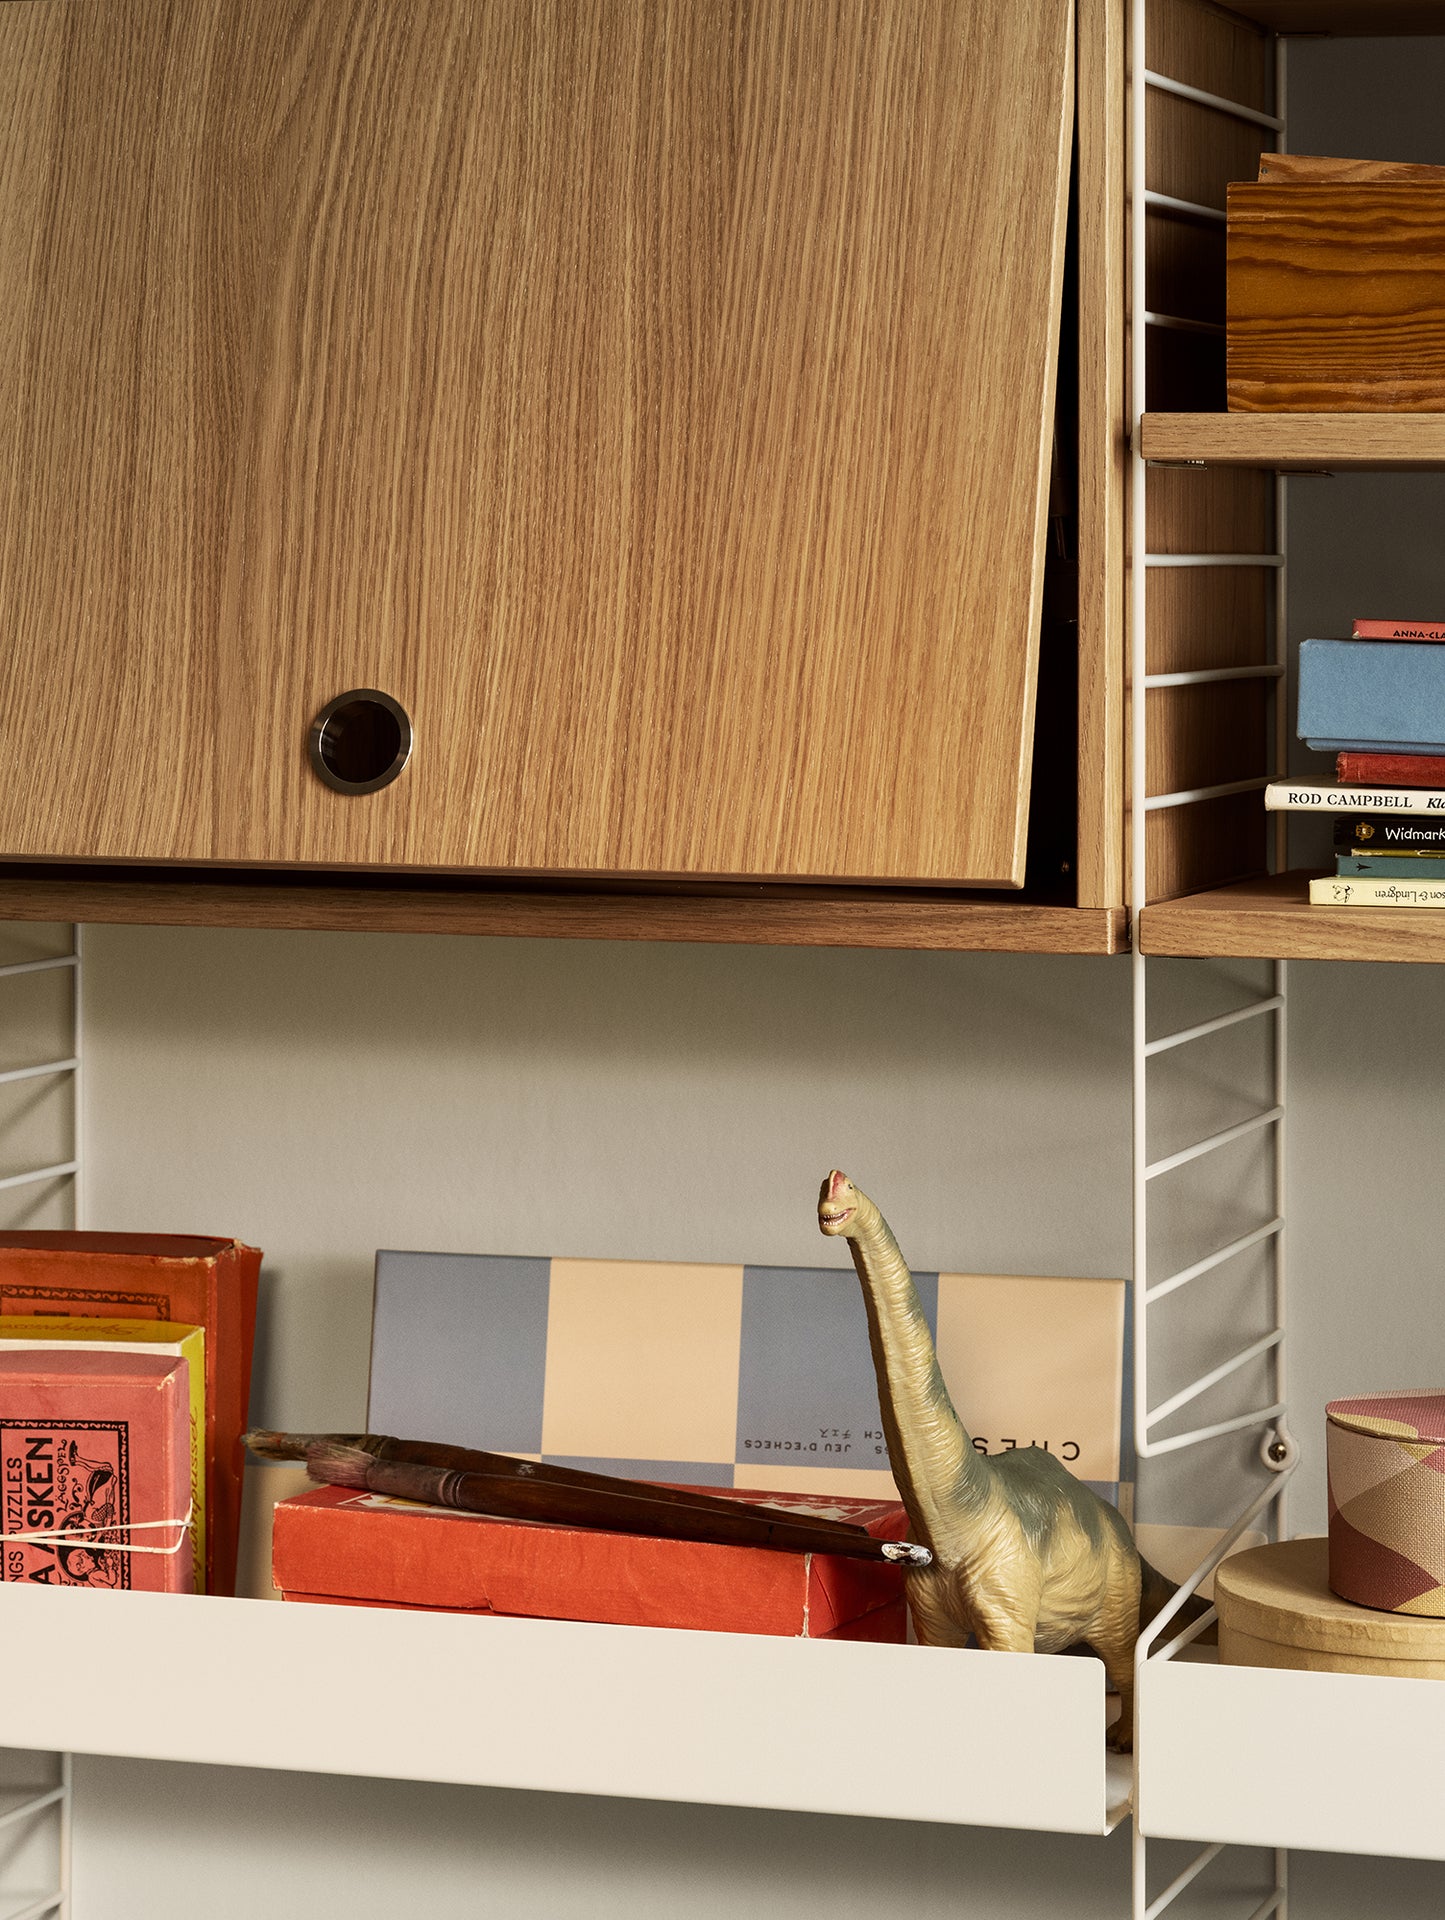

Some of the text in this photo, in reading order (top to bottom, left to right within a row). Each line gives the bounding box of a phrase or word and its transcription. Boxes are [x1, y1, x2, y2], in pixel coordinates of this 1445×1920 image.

[1288, 792, 1322, 805] ROD
[1326, 793, 1414, 809] CAMPBELL
[1374, 885, 1417, 903] Lindgren
[1418, 890, 1428, 901] &
[743, 1439, 817, 1452] D'ECHECS
[824, 1442, 852, 1453] JEU
[55, 1438, 70, 1514] LÄGGSPEL
